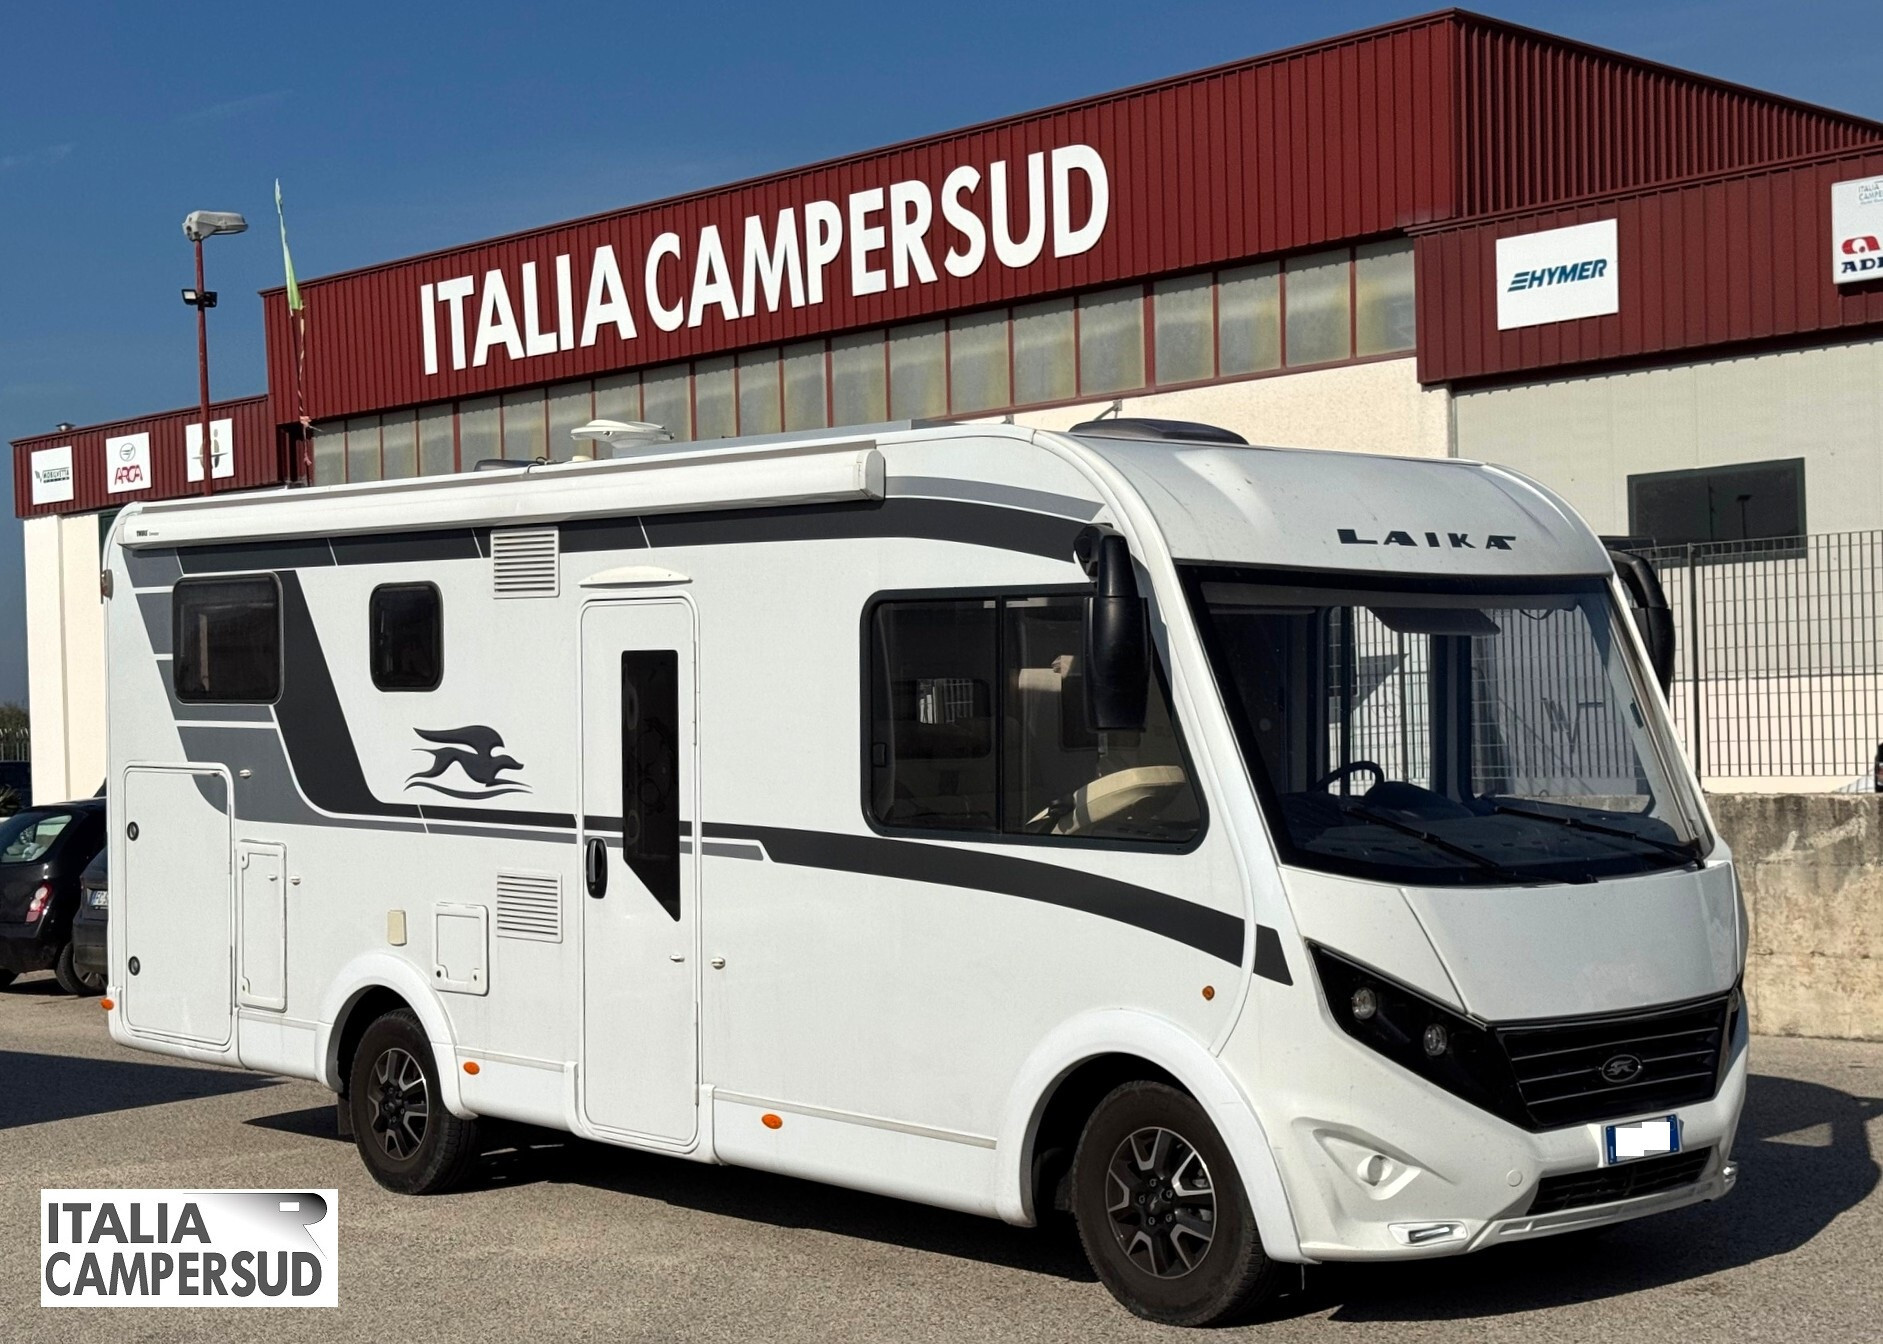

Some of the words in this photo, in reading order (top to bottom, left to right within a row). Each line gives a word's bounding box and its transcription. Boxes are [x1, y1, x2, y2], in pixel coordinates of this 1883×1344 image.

[1858, 184, 1880, 193] ITALIA
[420, 245, 638, 376] ITALIA
[645, 144, 1111, 332] CAMPERSUD
[1526, 259, 1608, 290] HYMER
[114, 464, 143, 485] ARCA
[1337, 529, 1516, 550] LAIKA
